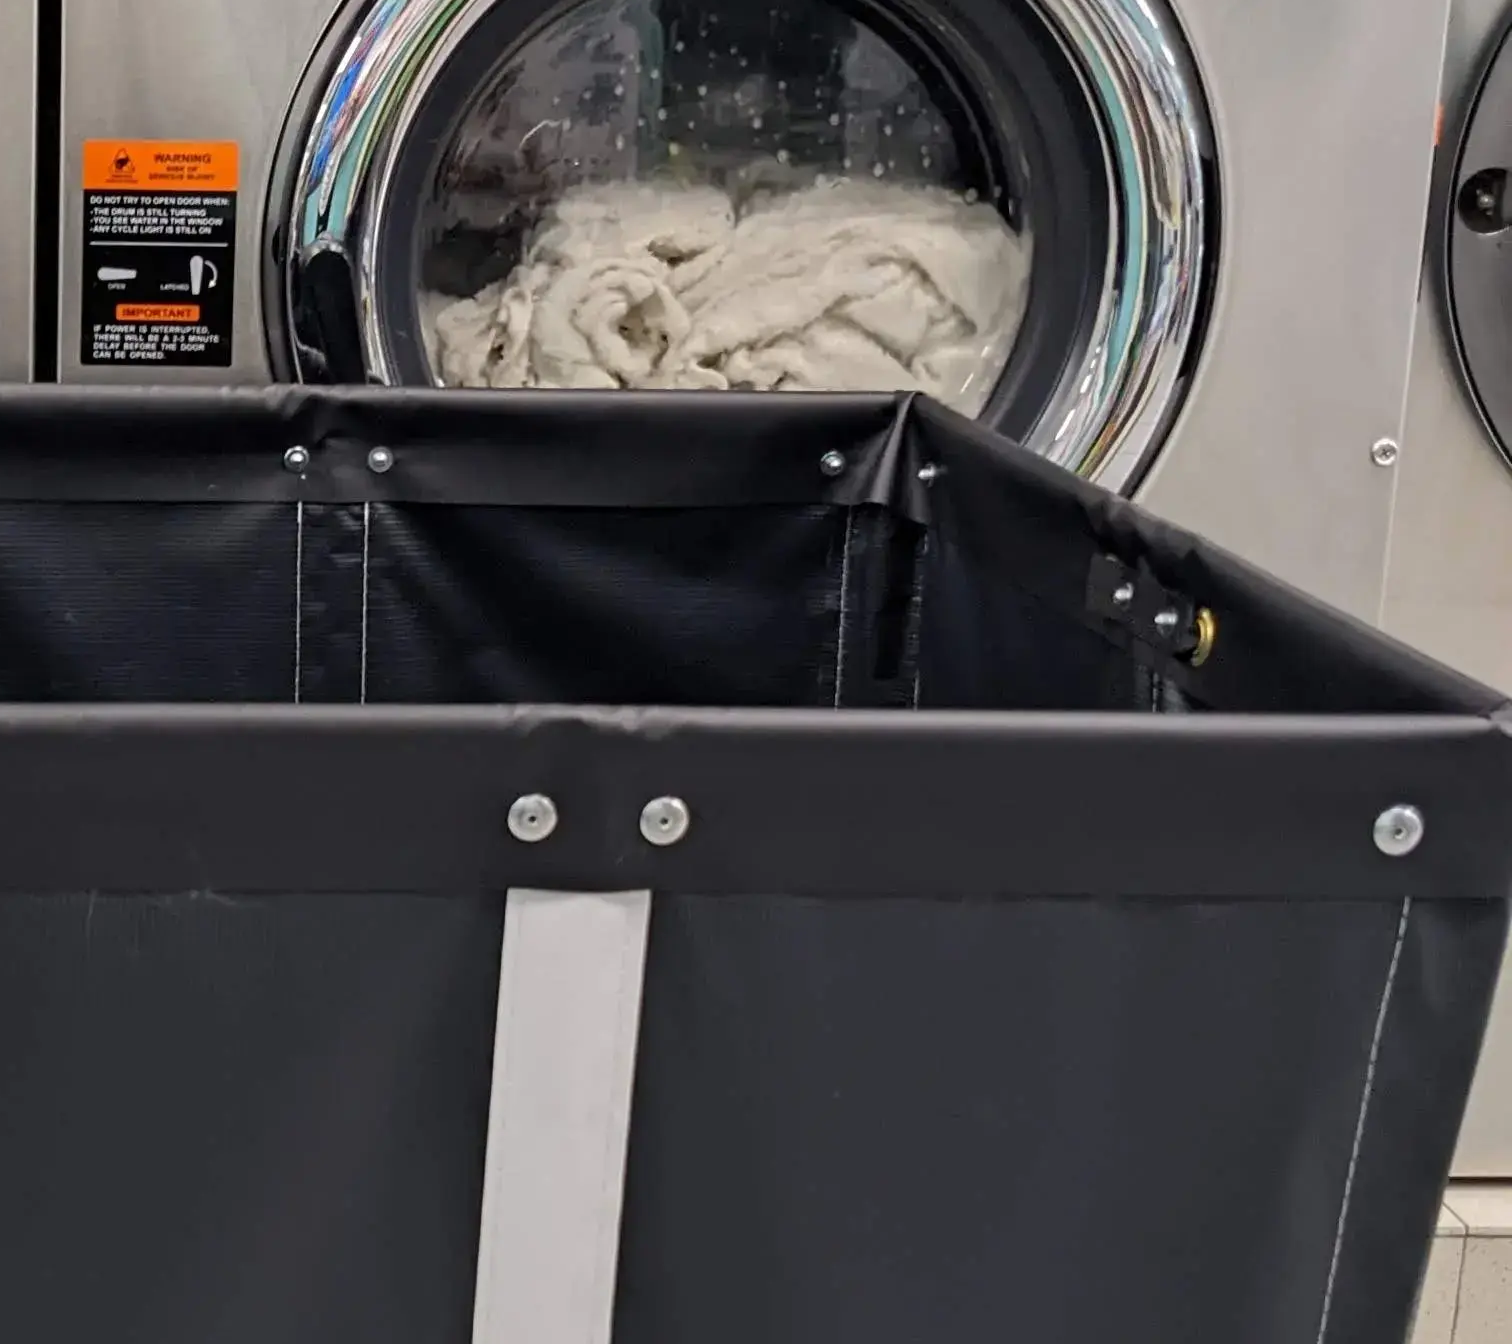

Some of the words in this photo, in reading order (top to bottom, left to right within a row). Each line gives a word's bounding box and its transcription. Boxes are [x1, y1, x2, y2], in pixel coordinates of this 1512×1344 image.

[154, 154, 212, 164] WARNING
[140, 197, 151, 205] TO
[153, 197, 175, 205] OPEN
[177, 197, 201, 205] DOOR
[122, 308, 192, 318] IMPORTANT
